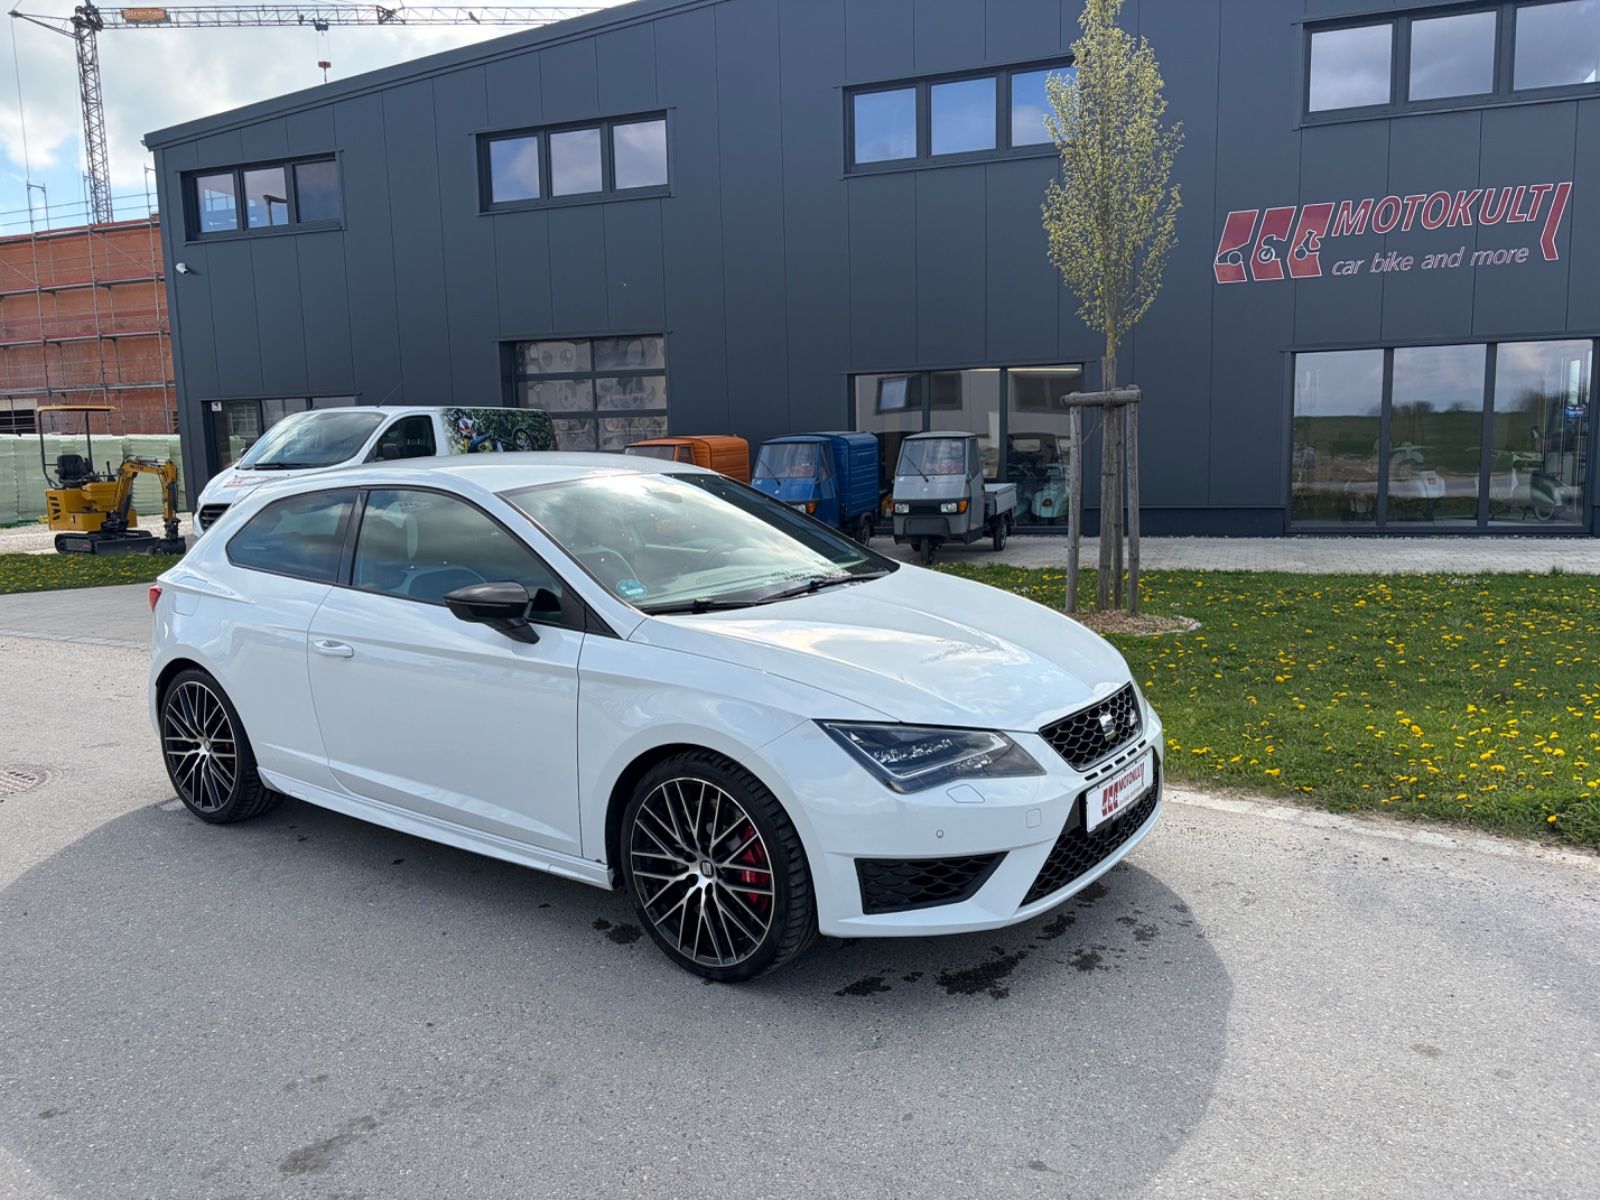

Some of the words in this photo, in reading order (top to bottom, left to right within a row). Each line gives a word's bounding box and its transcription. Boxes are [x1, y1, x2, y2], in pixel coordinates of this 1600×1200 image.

[1331, 183, 1554, 237] MOTOKULT
[1331, 258, 1365, 276] car
[1369, 251, 1414, 273] bike
[1420, 246, 1465, 270] and
[1470, 247, 1529, 266] more
